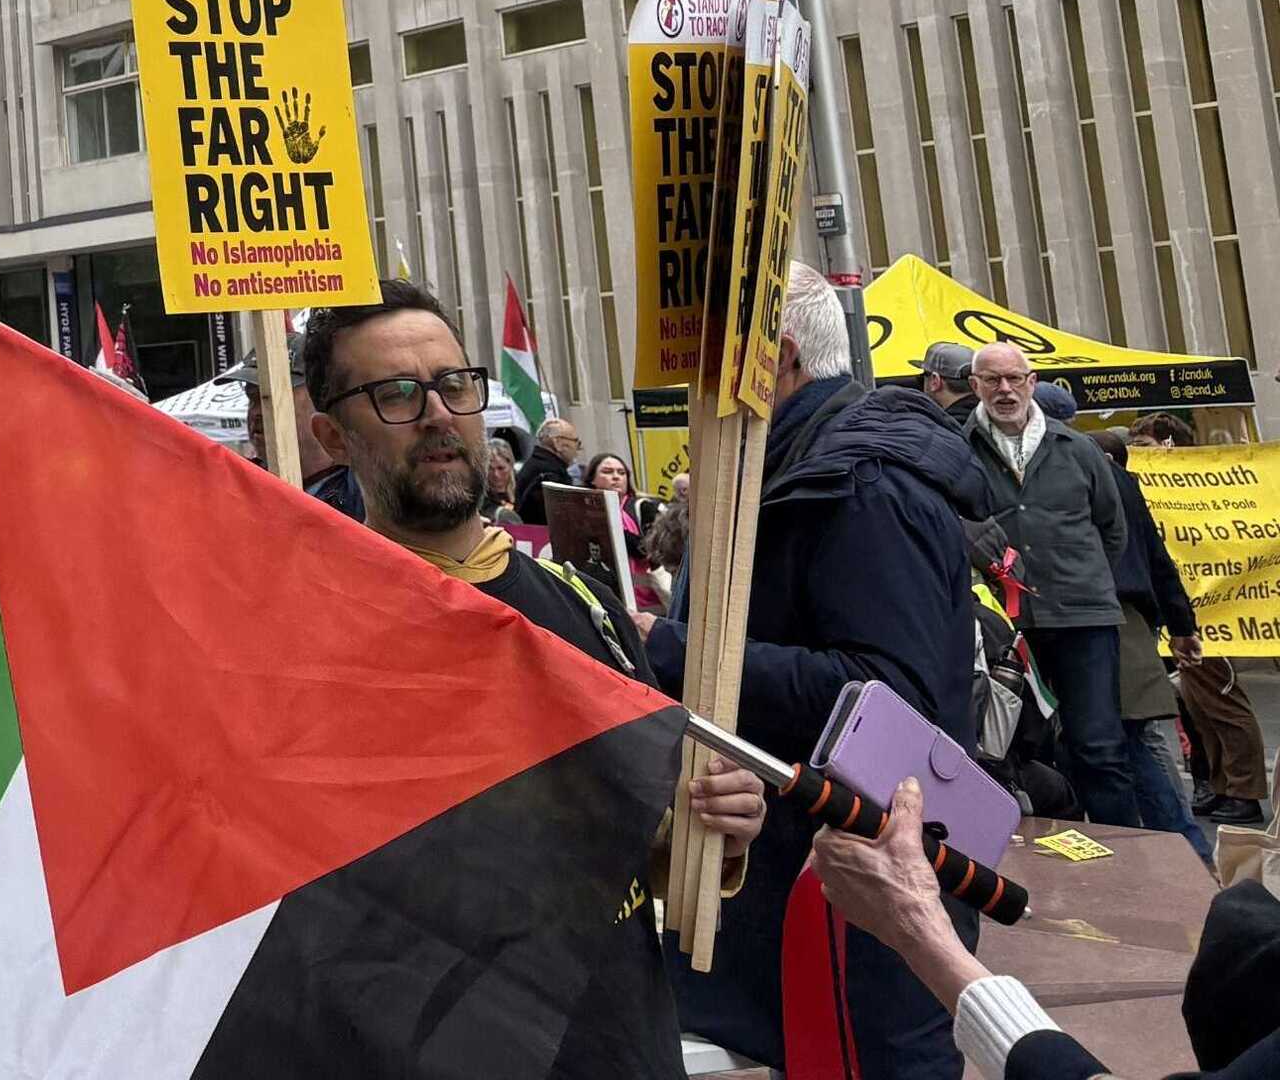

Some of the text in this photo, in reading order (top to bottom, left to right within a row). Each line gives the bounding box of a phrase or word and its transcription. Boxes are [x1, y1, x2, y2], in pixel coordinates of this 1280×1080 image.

[690, 17, 704, 35] TO
[169, 42, 269, 100] THE
[651, 51, 724, 112] STO
[178, 107, 273, 166] FAR
[185, 172, 334, 233] RIGHT
[191, 238, 342, 268] No Islamophobia
[194, 269, 344, 297] No antisemitism
[60, 302, 70, 333] HYDE
[1082, 371, 1156, 385] www.cnduk.org
[661, 454, 682, 480] for
[1136, 465, 1259, 488] urnemouth
[1211, 500, 1221, 510] &
[1223, 498, 1257, 510] Poole
[1175, 526, 1203, 546] up
[1205, 523, 1230, 540] to
